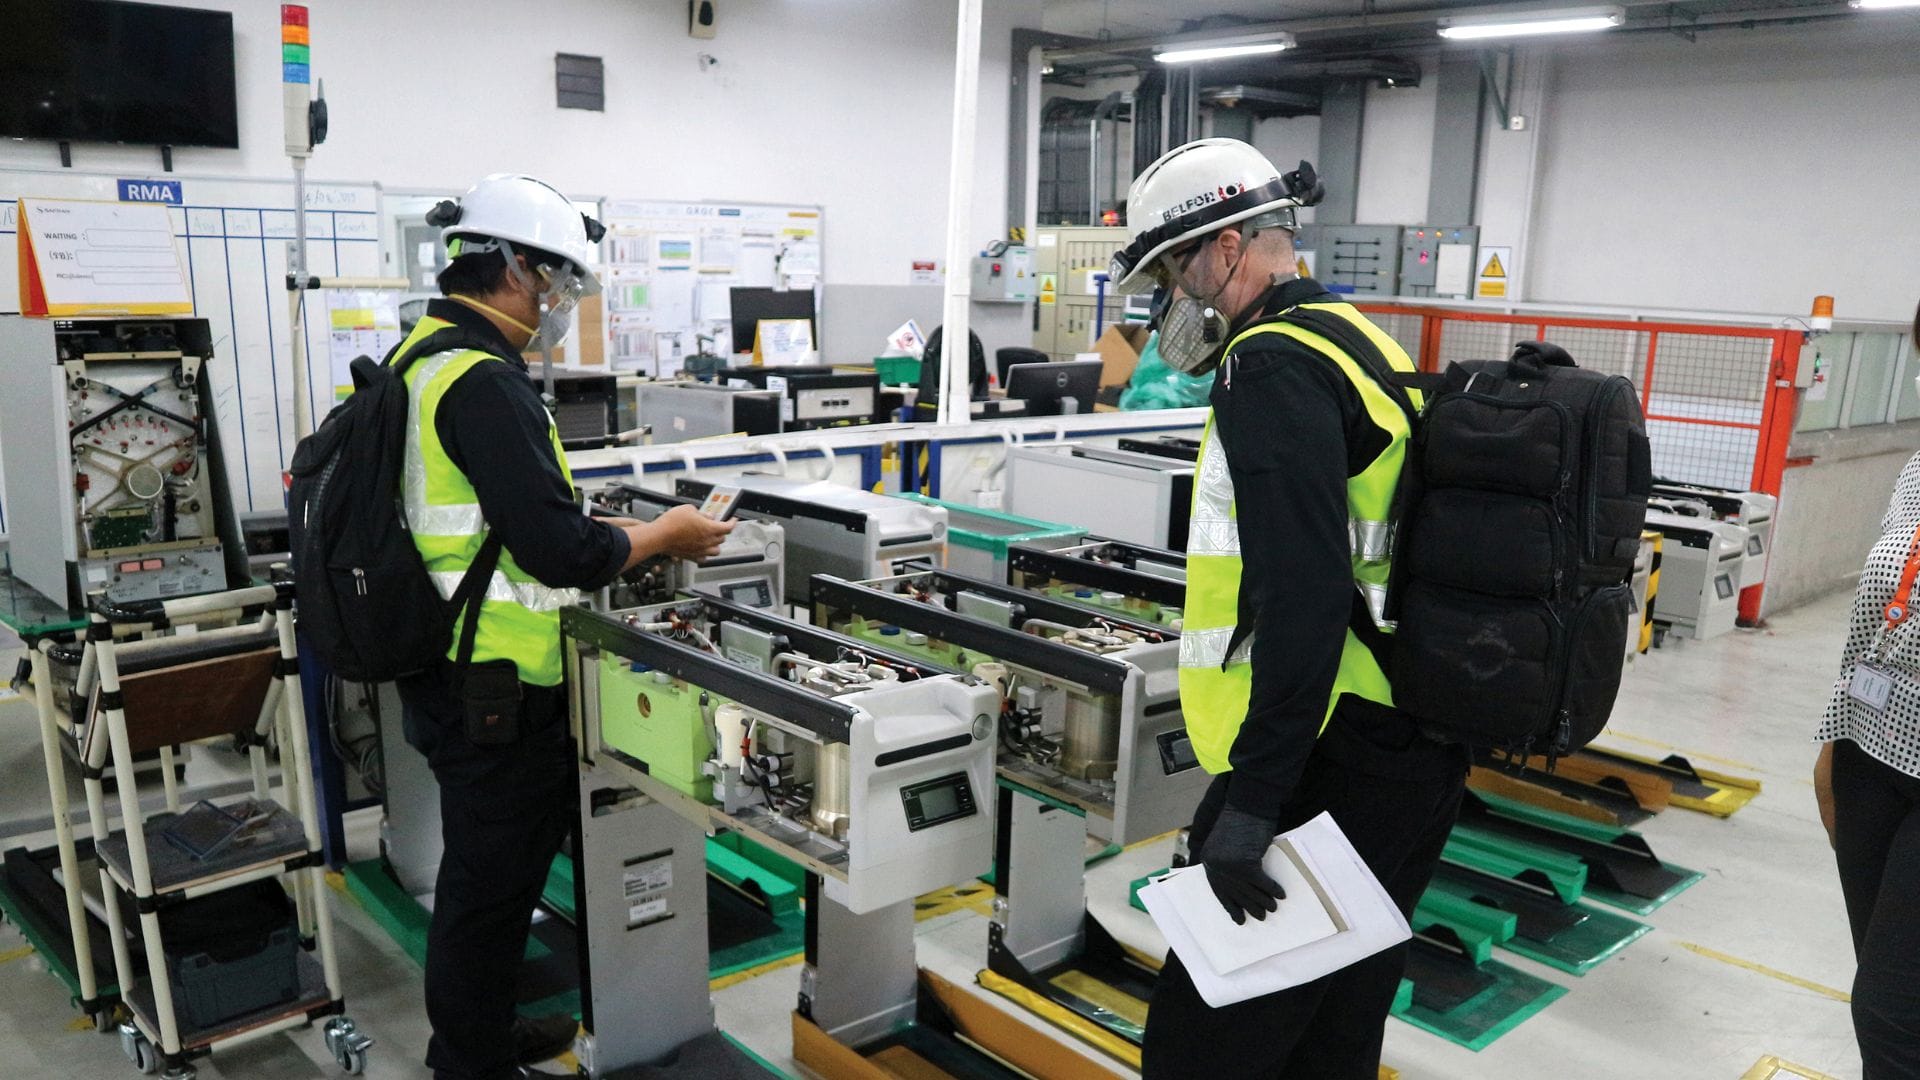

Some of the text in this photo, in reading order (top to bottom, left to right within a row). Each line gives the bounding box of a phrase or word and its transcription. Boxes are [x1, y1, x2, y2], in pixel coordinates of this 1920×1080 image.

[127, 184, 174, 201] RMA
[1162, 191, 1215, 222] BELFOR
[44, 232, 77, 240] WAITING
